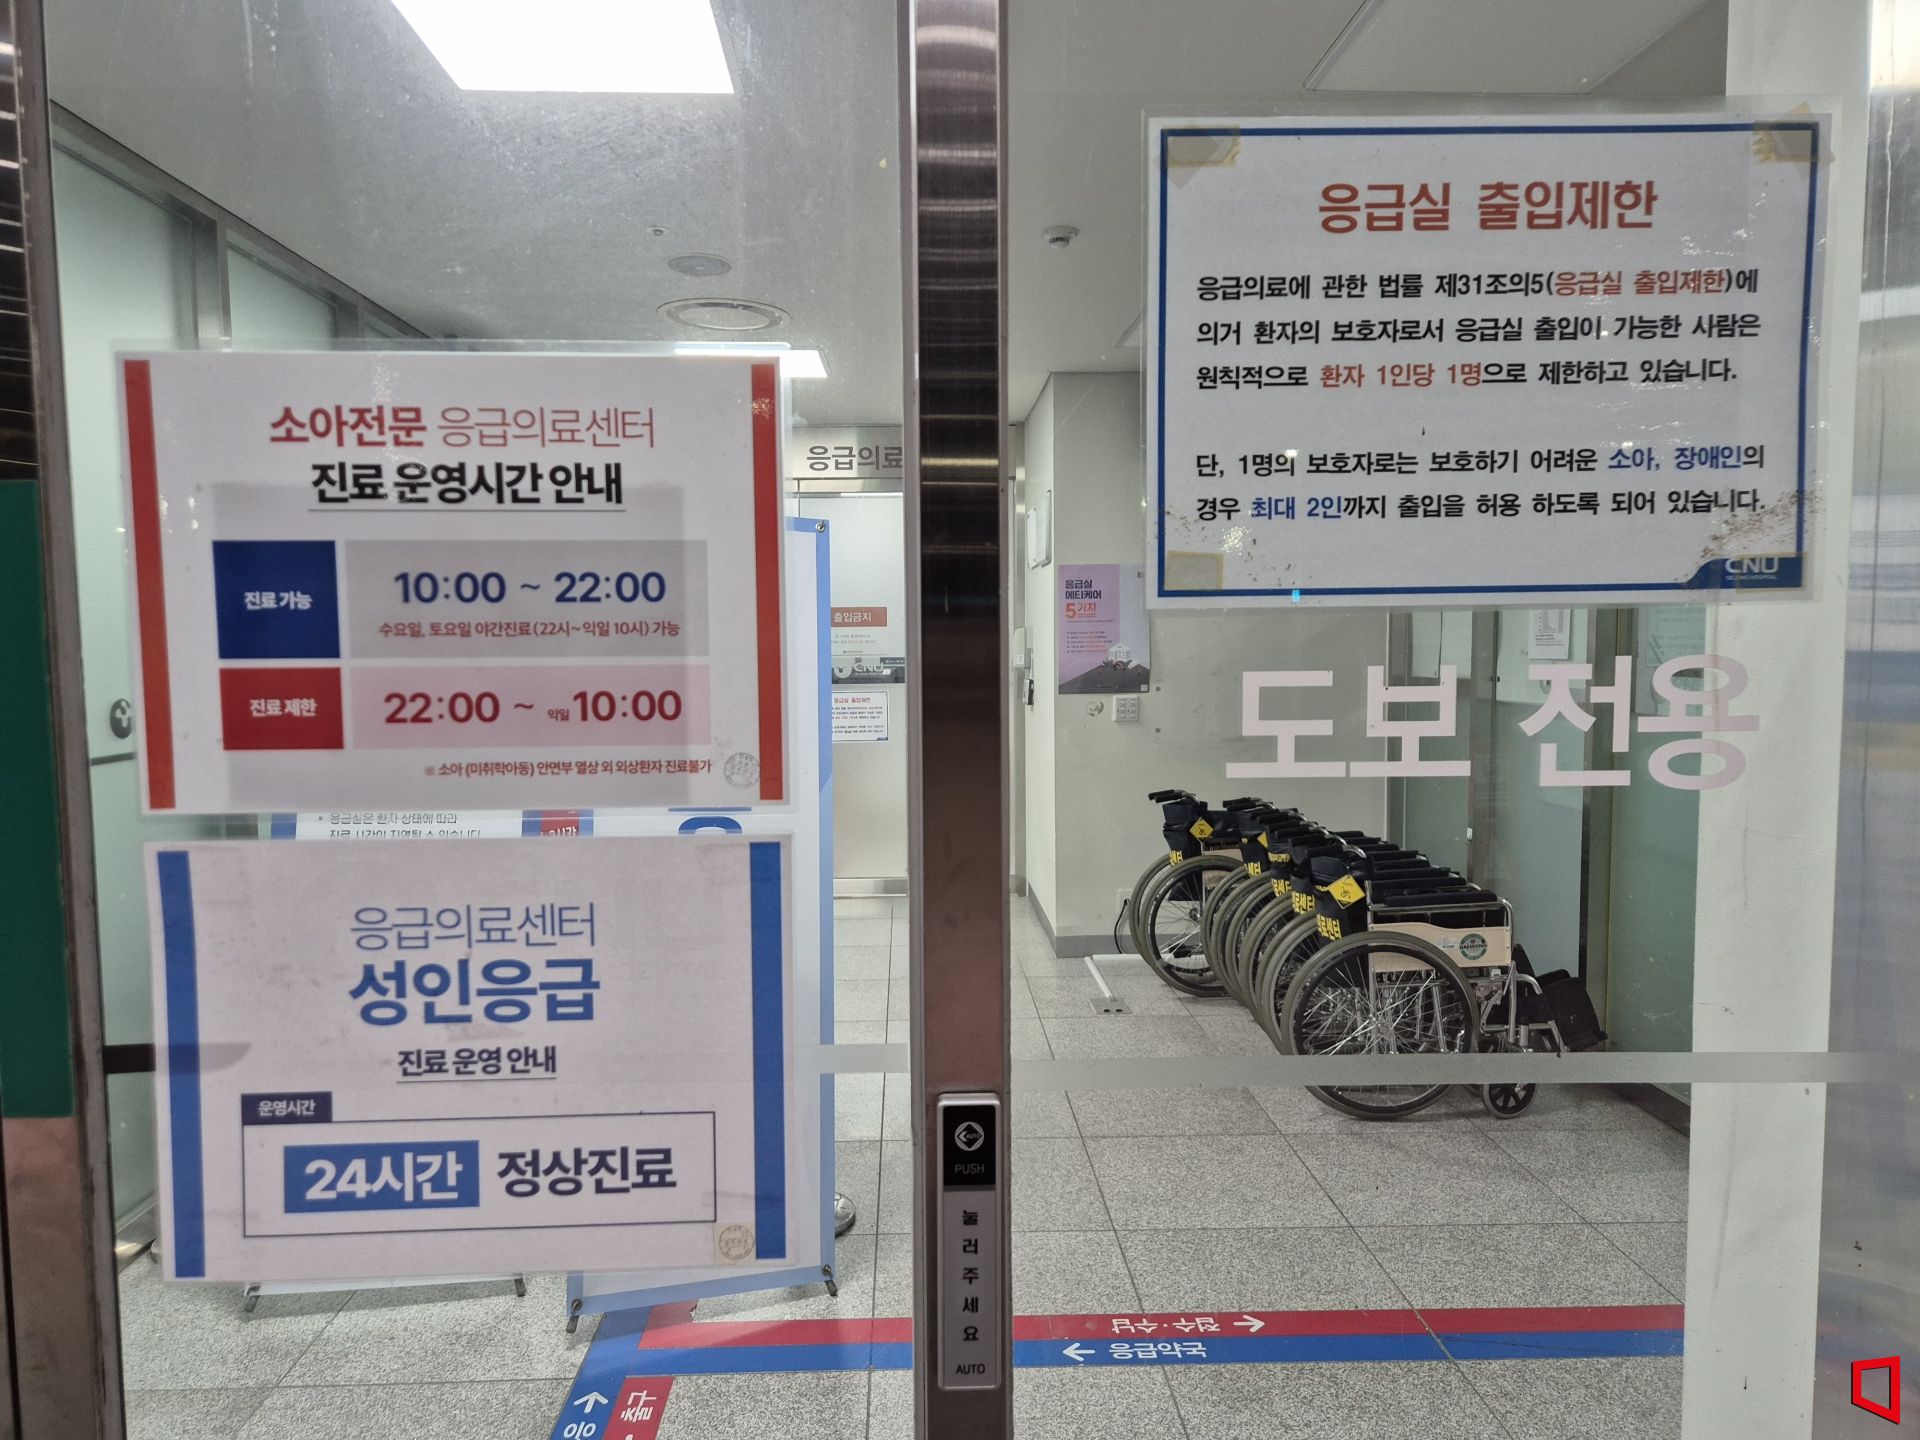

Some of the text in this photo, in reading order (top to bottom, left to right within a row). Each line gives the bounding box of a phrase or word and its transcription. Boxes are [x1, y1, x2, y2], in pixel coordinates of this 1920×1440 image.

[1318, 180, 1657, 232] 응급실 출입제한
[1197, 275, 1311, 301] 응급의료에
[1322, 274, 1368, 299] 관한
[1379, 274, 1423, 298] 법률
[1634, 268, 1759, 294] 출입제한)에
[1197, 313, 1761, 345] 의거 환자의 보호자로서 응급실 출입이 가능한 사람은
[1196, 358, 1737, 389] 원칙적으로 환자 1인당 1명으로 제한하고 있습니다.
[269, 404, 655, 448] 소아전문 응급의료센터
[1196, 445, 1765, 477] 단, 1명의 보호자로는 보호하기 어려운 소아, 장애인의
[311, 462, 623, 504] 진료 운영시간 안내
[1197, 489, 1765, 521] 경우 최대 2인까지 출입을 허용 하도록 되어 있습니다.
[244, 590, 313, 610] 진료 가능
[394, 571, 507, 604] 10:00
[554, 571, 667, 603] 22:00
[1065, 579, 1093, 590] 응급실
[379, 622, 425, 638] 수요일,
[429, 622, 472, 637] 토요일
[614, 622, 649, 636] 10시)
[652, 621, 680, 636] 가능
[833, 611, 872, 623] 출입금지
[250, 698, 318, 717] 진료 제한
[384, 691, 500, 724] 22:00
[547, 708, 570, 722] 익일
[573, 690, 682, 722] 10:00
[1226, 654, 1760, 791] 도보 전용
[437, 763, 462, 776] 소아
[465, 761, 535, 777] (미취학아동)
[536, 761, 573, 776] 안면부
[575, 761, 599, 775] 열상
[601, 760, 613, 775] 외
[615, 760, 662, 775] 외상환자
[665, 759, 712, 774] 진료불가
[350, 902, 596, 951] 응급의료센터
[348, 958, 600, 1026] 성인응급
[398, 1046, 556, 1077] 진료 운영 안내
[257, 1099, 316, 1116] 운영시간
[305, 1146, 677, 1202] 24시간 정상진료
[954, 1163, 985, 1175] PUSH
[1108, 1342, 1207, 1360] 응급약국
[955, 1363, 986, 1375] AUTO
